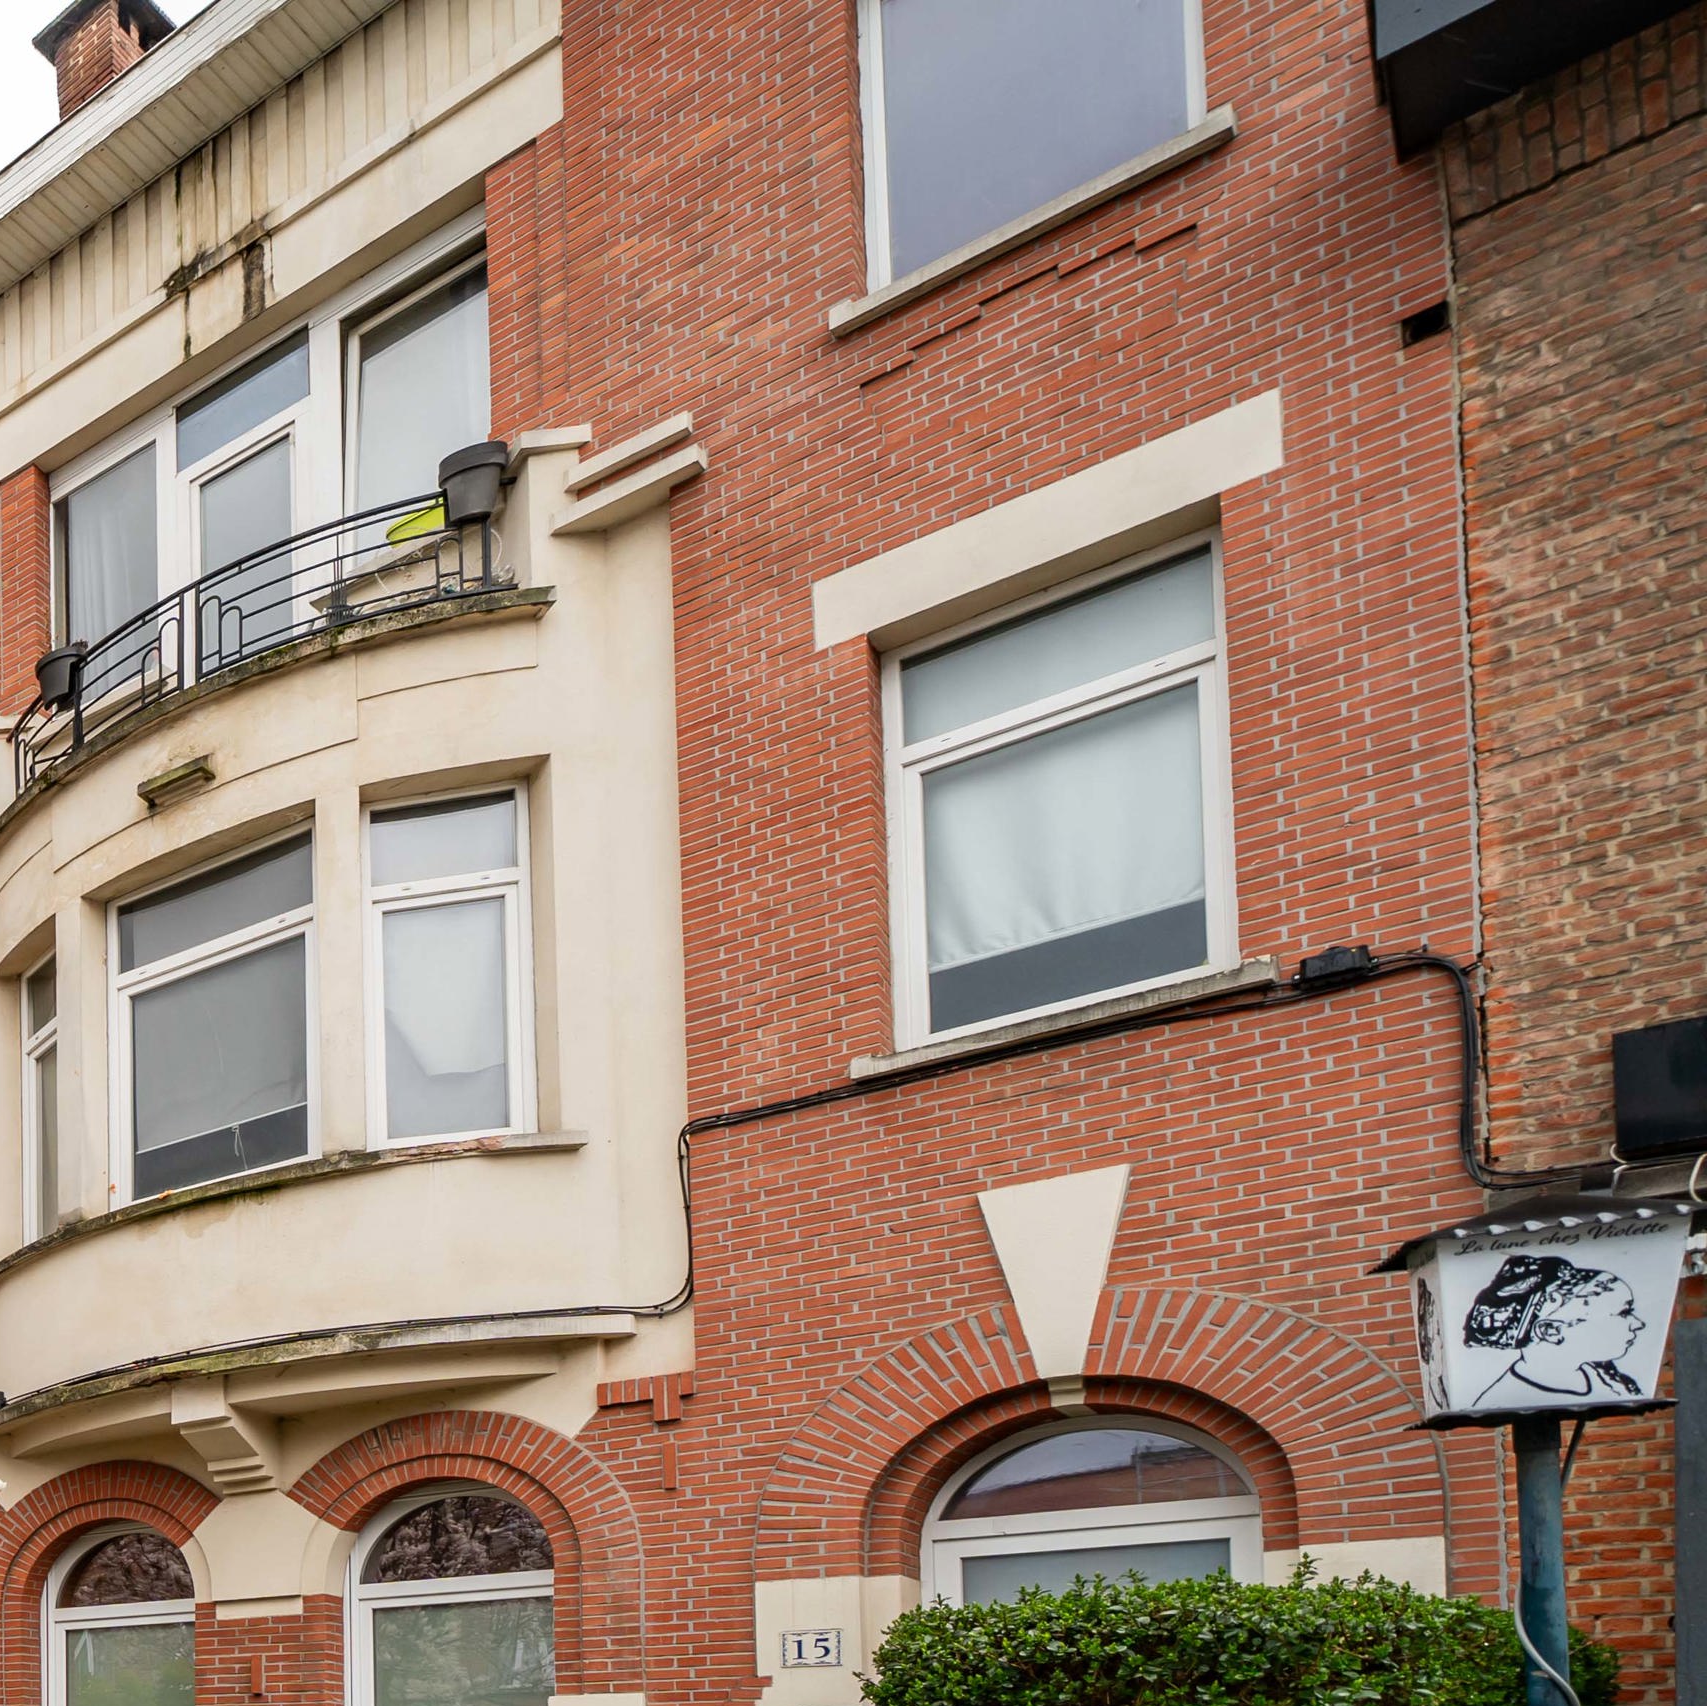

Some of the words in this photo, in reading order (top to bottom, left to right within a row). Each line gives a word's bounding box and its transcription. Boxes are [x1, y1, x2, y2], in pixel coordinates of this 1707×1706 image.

[1454, 1239, 1483, 1256] La
[1489, 1239, 1530, 1251] lune
[1539, 1232, 1580, 1246] chez
[1587, 1221, 1670, 1241] Violette
[791, 1638, 830, 1660] 15
